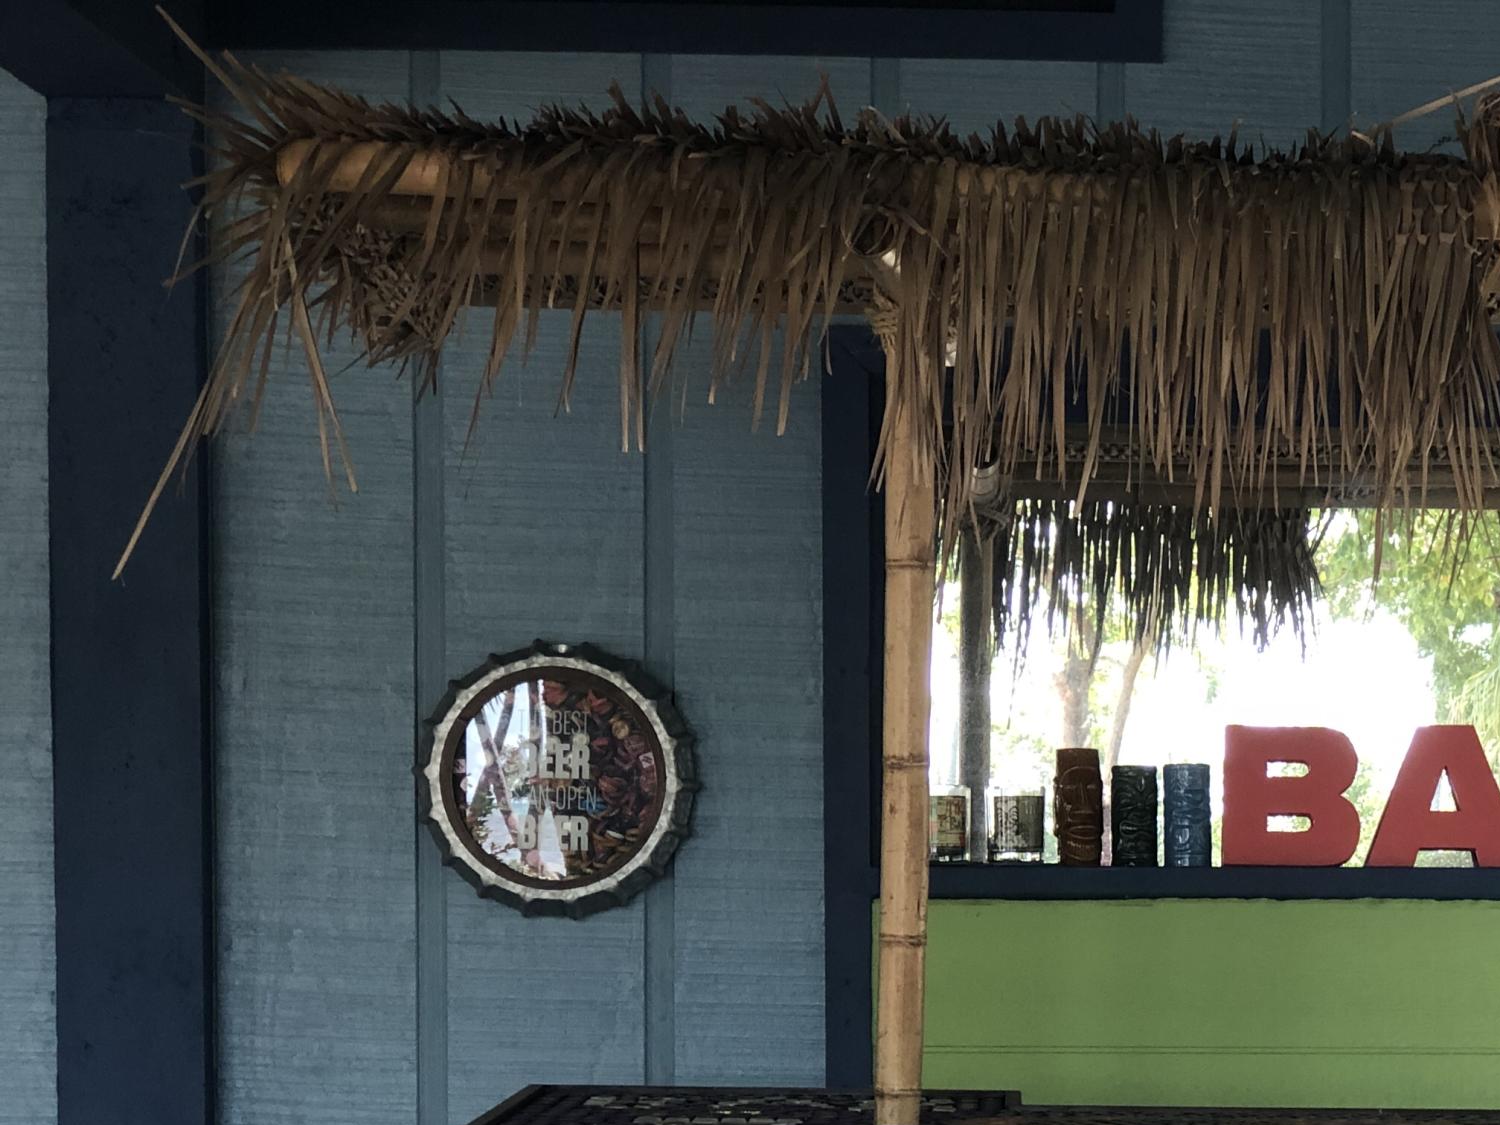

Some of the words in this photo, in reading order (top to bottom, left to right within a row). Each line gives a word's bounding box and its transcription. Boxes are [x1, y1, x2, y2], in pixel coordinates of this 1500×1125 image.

[518, 709, 549, 734] TH
[552, 710, 590, 735] BEST
[556, 786, 597, 811] OPEN
[517, 815, 590, 851] BER
